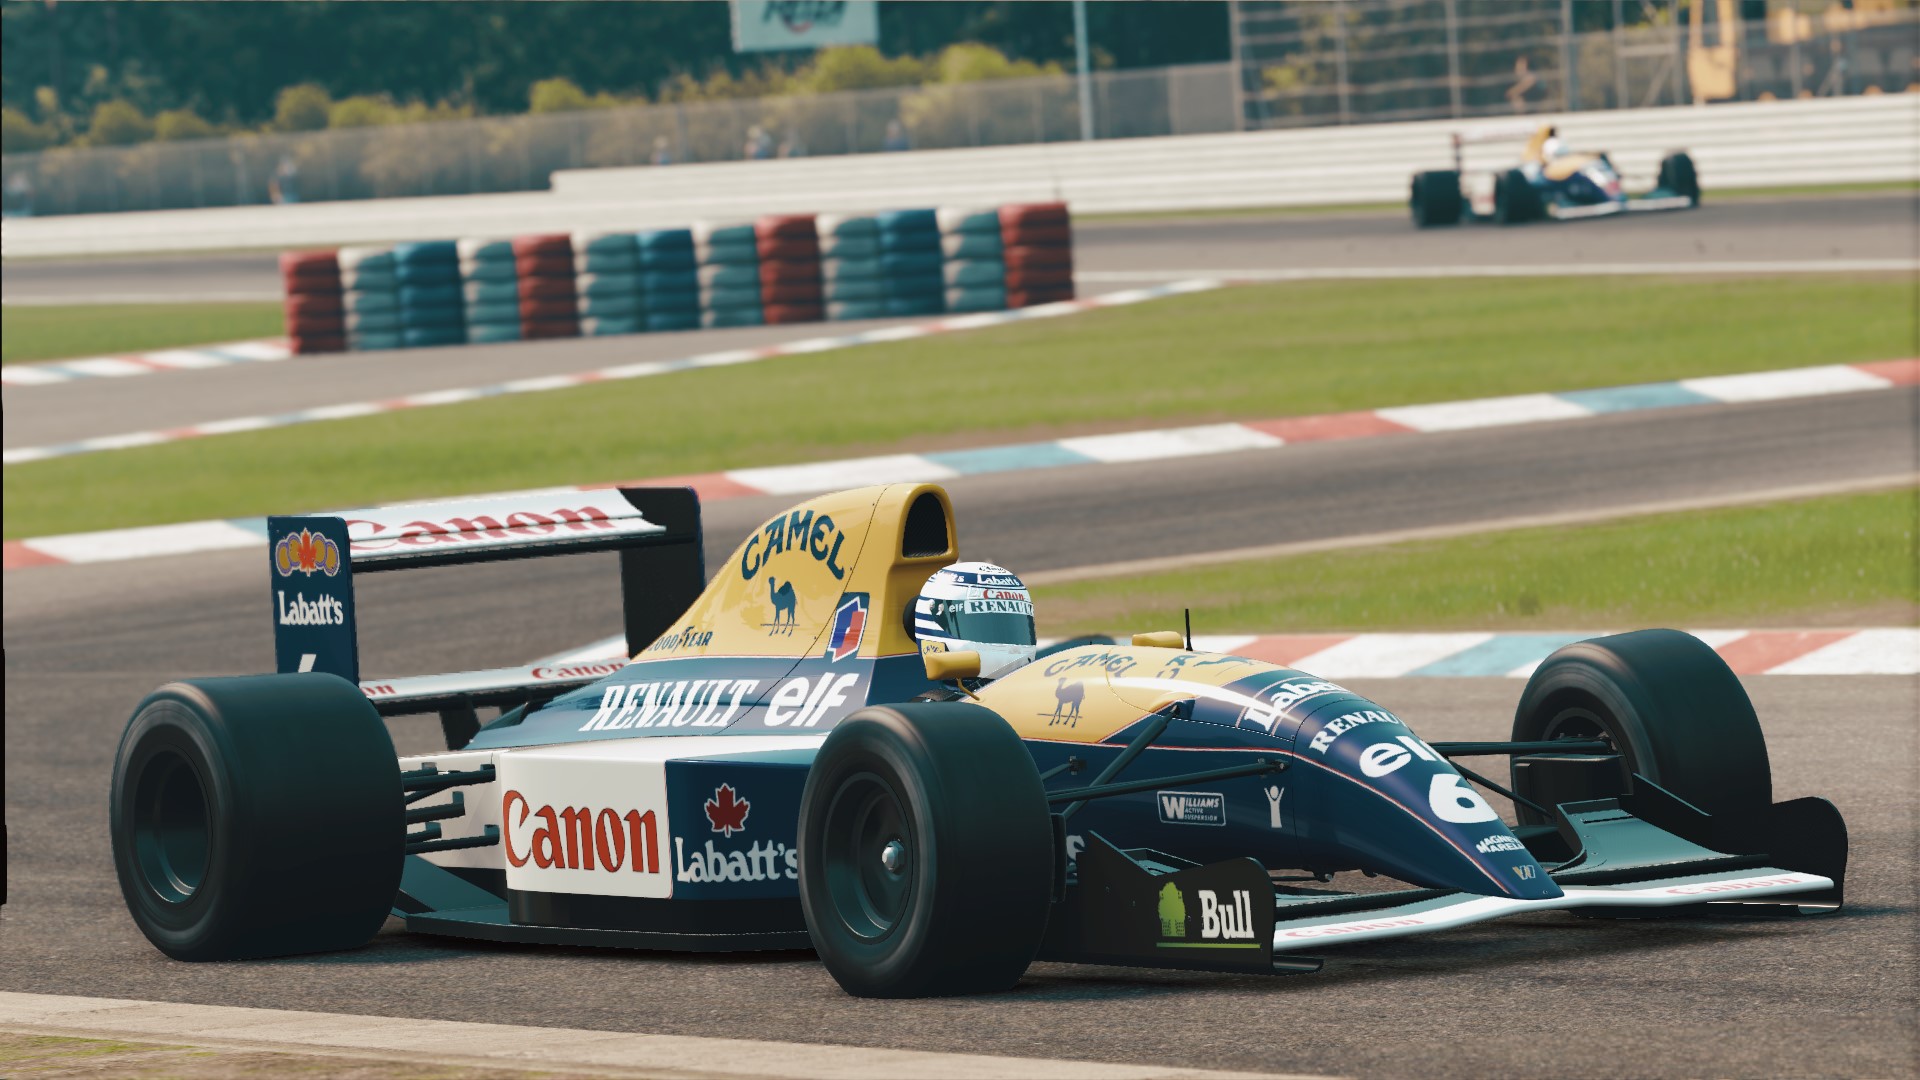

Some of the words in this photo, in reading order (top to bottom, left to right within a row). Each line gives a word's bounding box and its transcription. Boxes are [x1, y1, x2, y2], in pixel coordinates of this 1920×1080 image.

[345, 505, 609, 551] Canon
[741, 509, 846, 580] CAMEL
[278, 590, 344, 626] Labatt's
[949, 603, 964, 613] elf
[983, 588, 1025, 601] Canon
[578, 679, 760, 732] RENAULT
[763, 672, 860, 728] elf
[1162, 796, 1220, 820] WILLIAMS
[1428, 773, 1498, 824] 6
[502, 789, 660, 874] Canon
[674, 836, 799, 884] Labatt's
[1666, 878, 1803, 895] Canon
[1198, 890, 1255, 939] Bull
[1285, 919, 1425, 938] Canon
